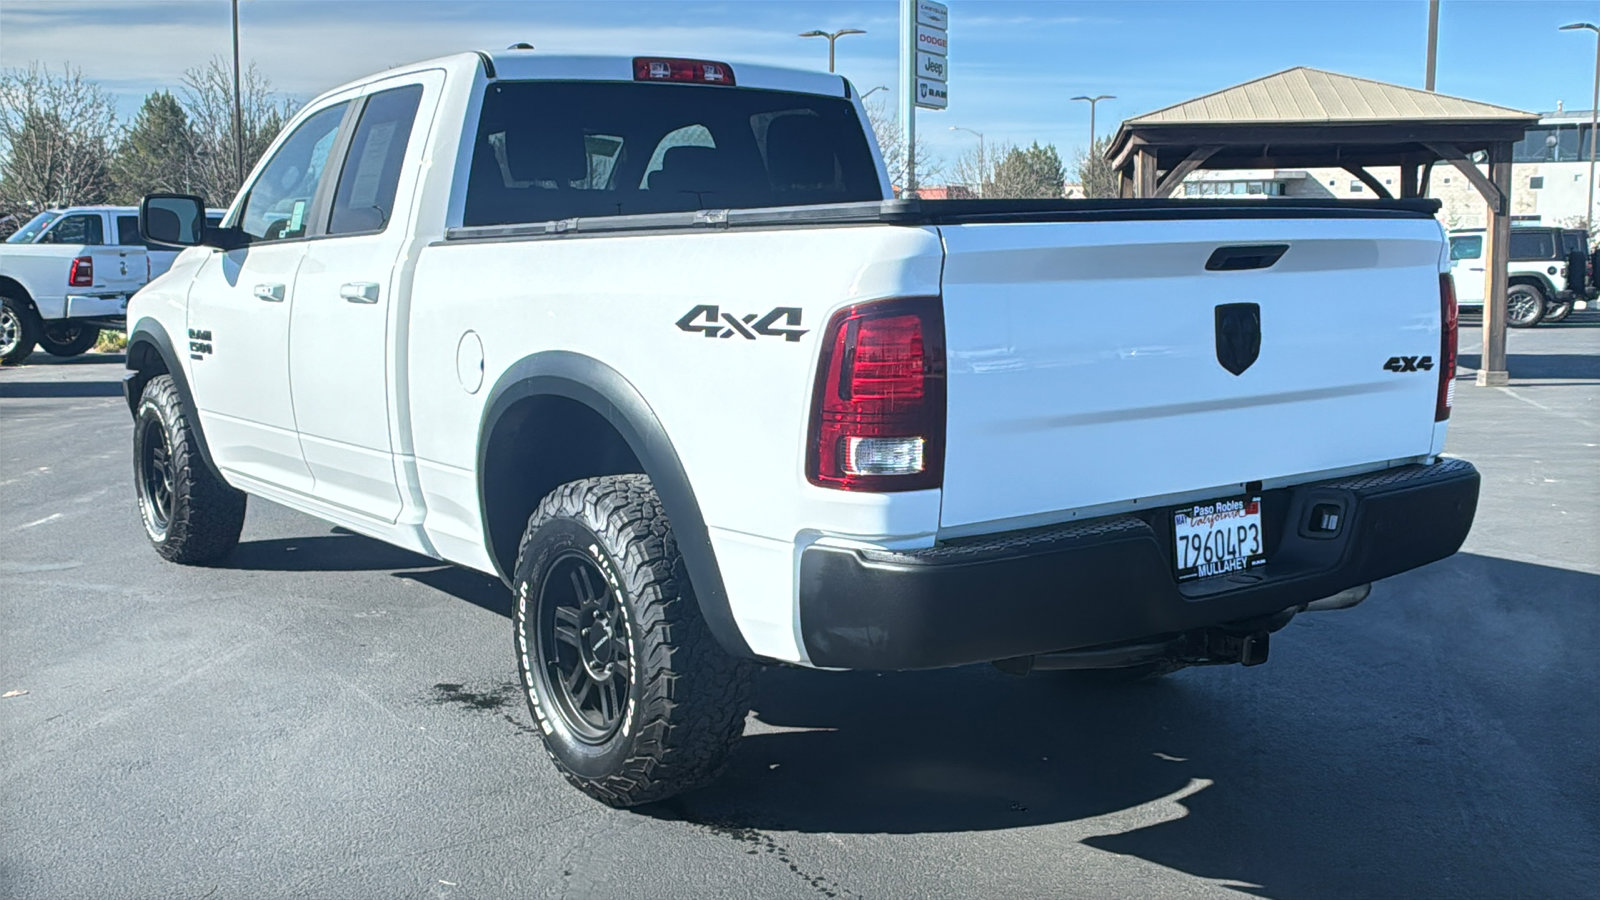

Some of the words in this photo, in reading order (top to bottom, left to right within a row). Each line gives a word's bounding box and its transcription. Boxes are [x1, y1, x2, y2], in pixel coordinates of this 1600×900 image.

[920, 34, 947, 47] DODGE
[925, 57, 943, 76] Jeep
[928, 88, 947, 98] RAM
[1193, 505, 1214, 517] Paso
[1216, 500, 1243, 512] Robles
[1179, 523, 1260, 568] 79604P3
[1198, 556, 1248, 577] MULLAHEY
